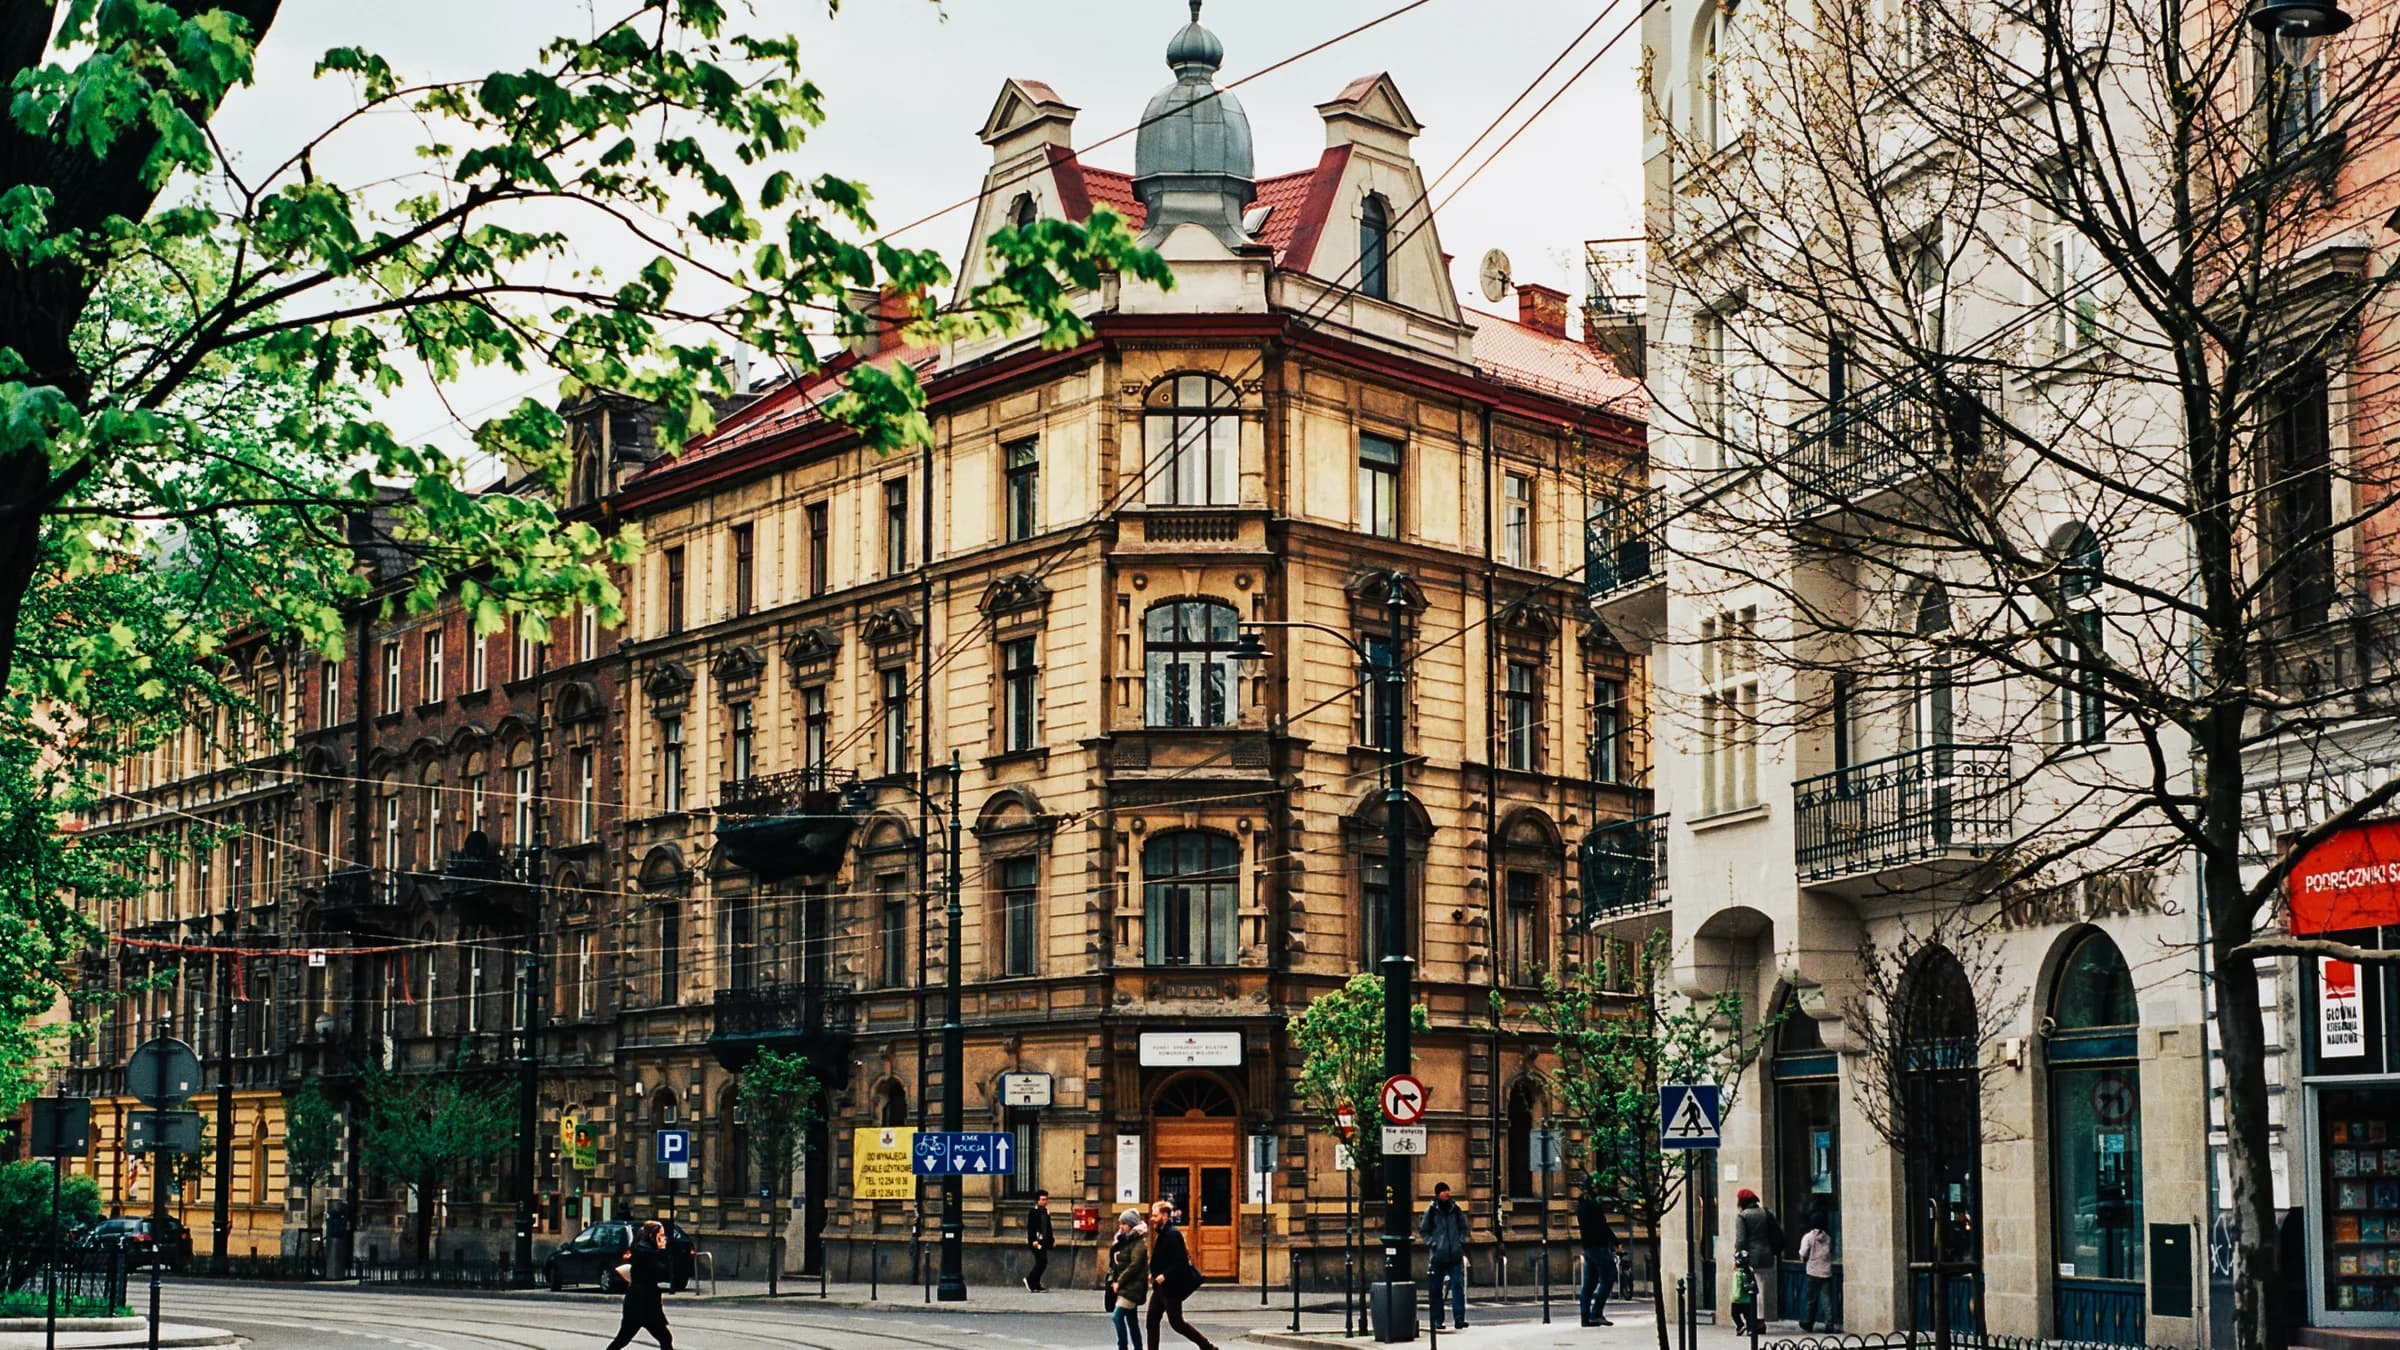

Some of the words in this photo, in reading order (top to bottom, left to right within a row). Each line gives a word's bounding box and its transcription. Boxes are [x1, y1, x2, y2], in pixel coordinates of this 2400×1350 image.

[2083, 871, 2162, 918] BANK
[664, 1134, 682, 1159] P
[954, 1144, 986, 1152] POLICJA
